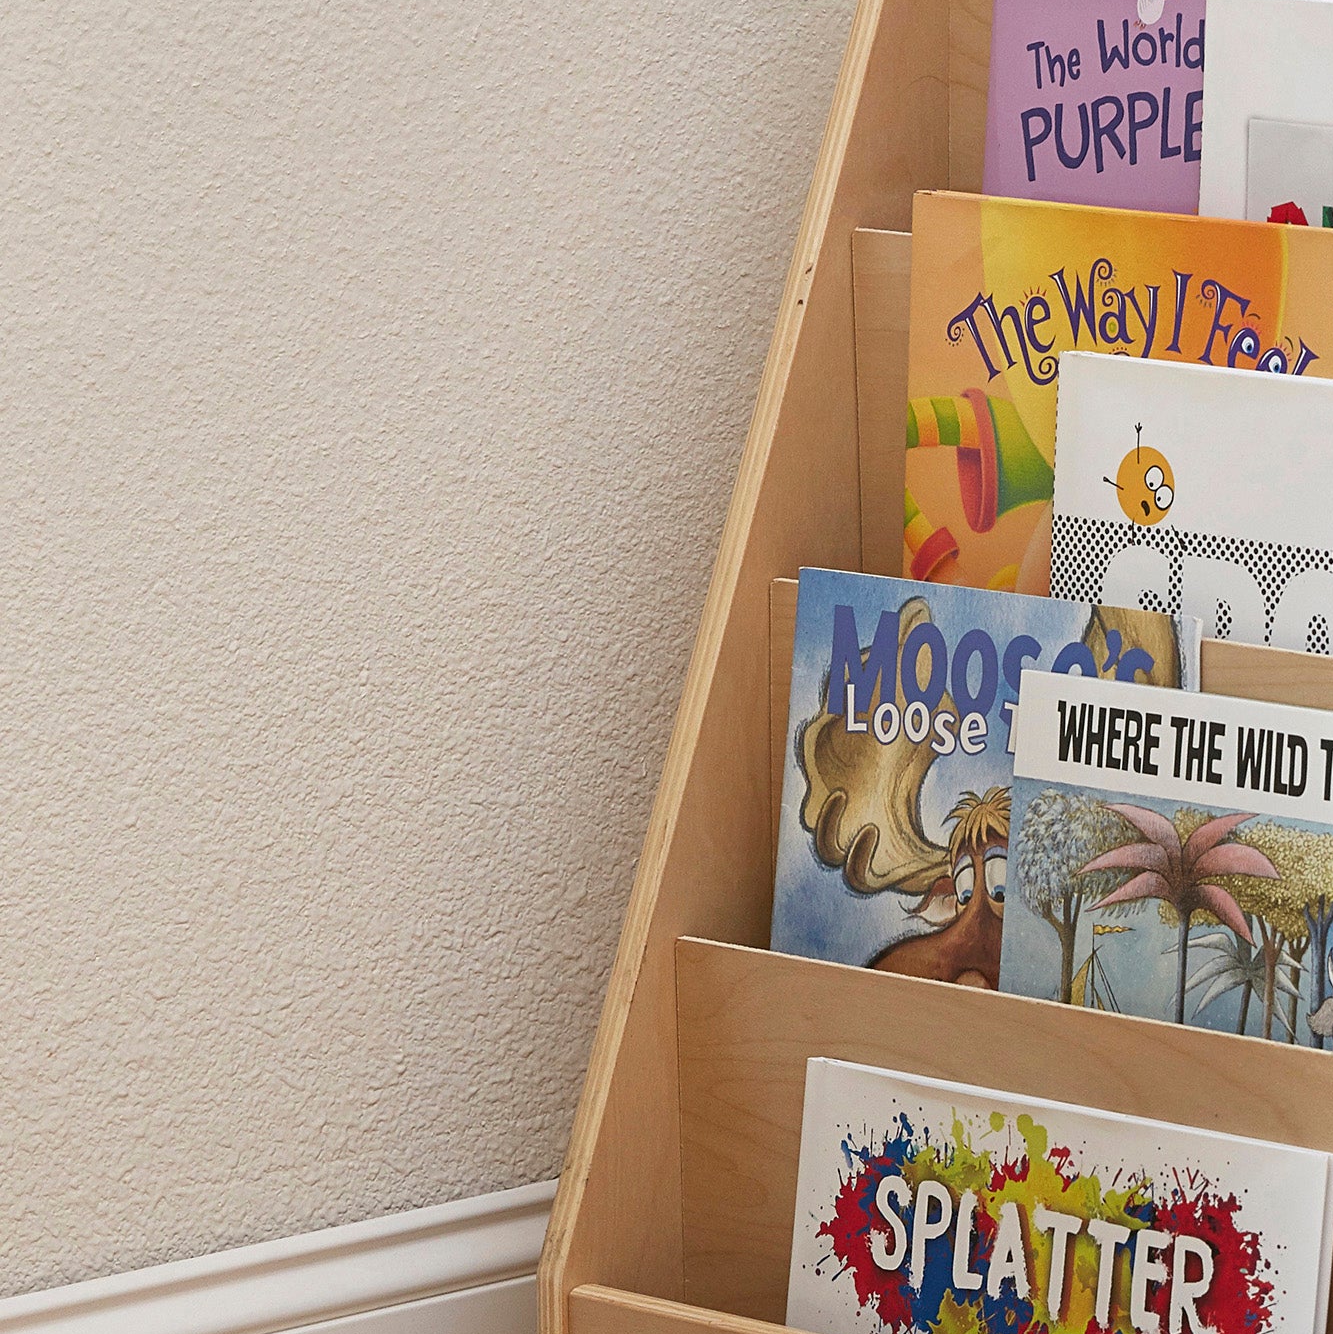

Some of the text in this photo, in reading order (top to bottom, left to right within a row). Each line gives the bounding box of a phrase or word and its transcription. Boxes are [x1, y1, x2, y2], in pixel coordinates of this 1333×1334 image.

[1026, 13, 1204, 90] The World
[1020, 86, 1203, 182] PURPLE
[946, 291, 1059, 386] The
[1049, 258, 1161, 359] Way
[1165, 268, 1194, 355] I
[846, 683, 988, 755] Loose
[1057, 699, 1162, 777] WHERE
[1170, 716, 1223, 784] THE
[1235, 728, 1308, 798] WILD
